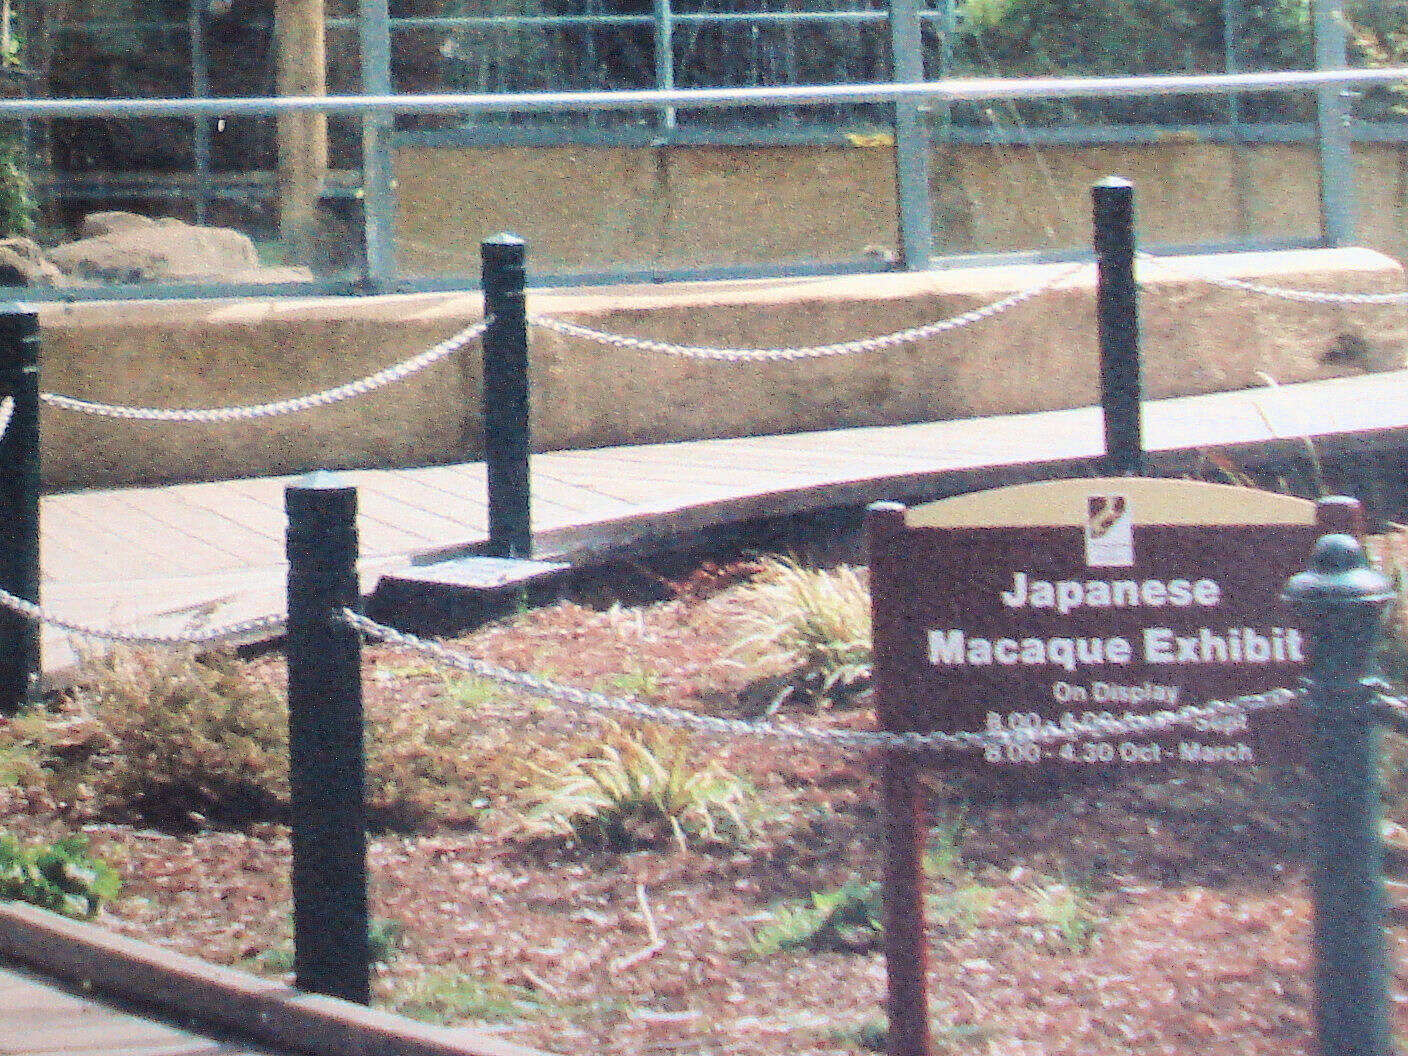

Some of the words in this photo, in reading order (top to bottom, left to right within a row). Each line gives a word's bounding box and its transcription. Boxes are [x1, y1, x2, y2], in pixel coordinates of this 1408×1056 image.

[1002, 572, 1221, 613] Japanese
[927, 629, 1132, 670] Macaque
[1143, 628, 1304, 663] Exhibit
[1052, 682, 1088, 702] On
[1092, 682, 1179, 704] Display
[1119, 742, 1160, 762] Oct
[1178, 742, 1252, 762] March
